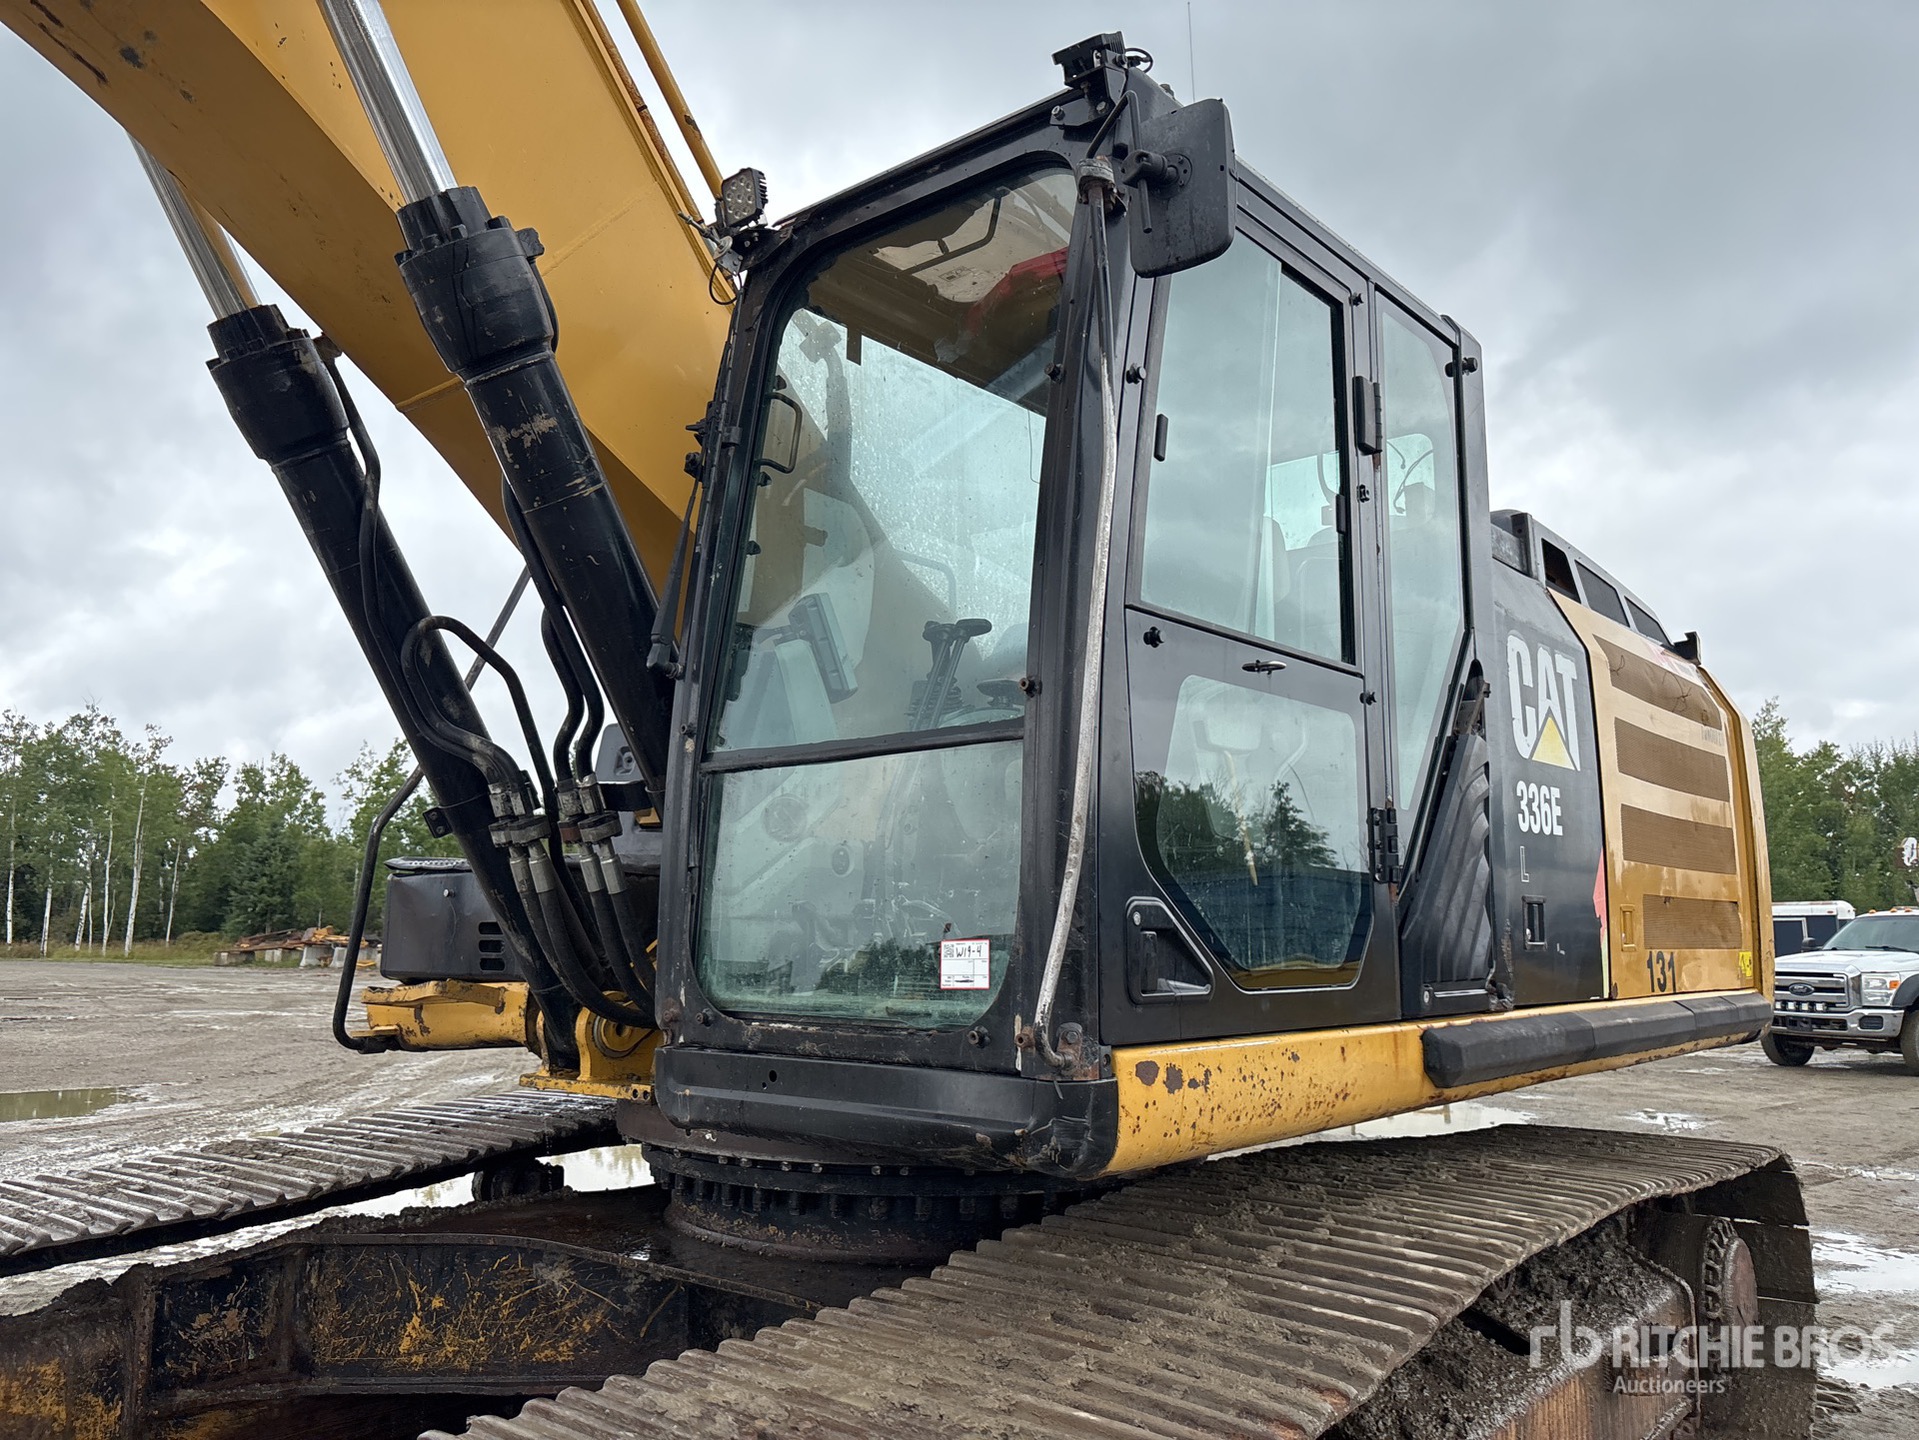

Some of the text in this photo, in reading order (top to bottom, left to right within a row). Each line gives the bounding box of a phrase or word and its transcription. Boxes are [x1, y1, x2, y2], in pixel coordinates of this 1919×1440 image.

[1507, 631, 1581, 771] CAT
[1516, 780, 1563, 836] 336E
[1646, 950, 1676, 993] 131
